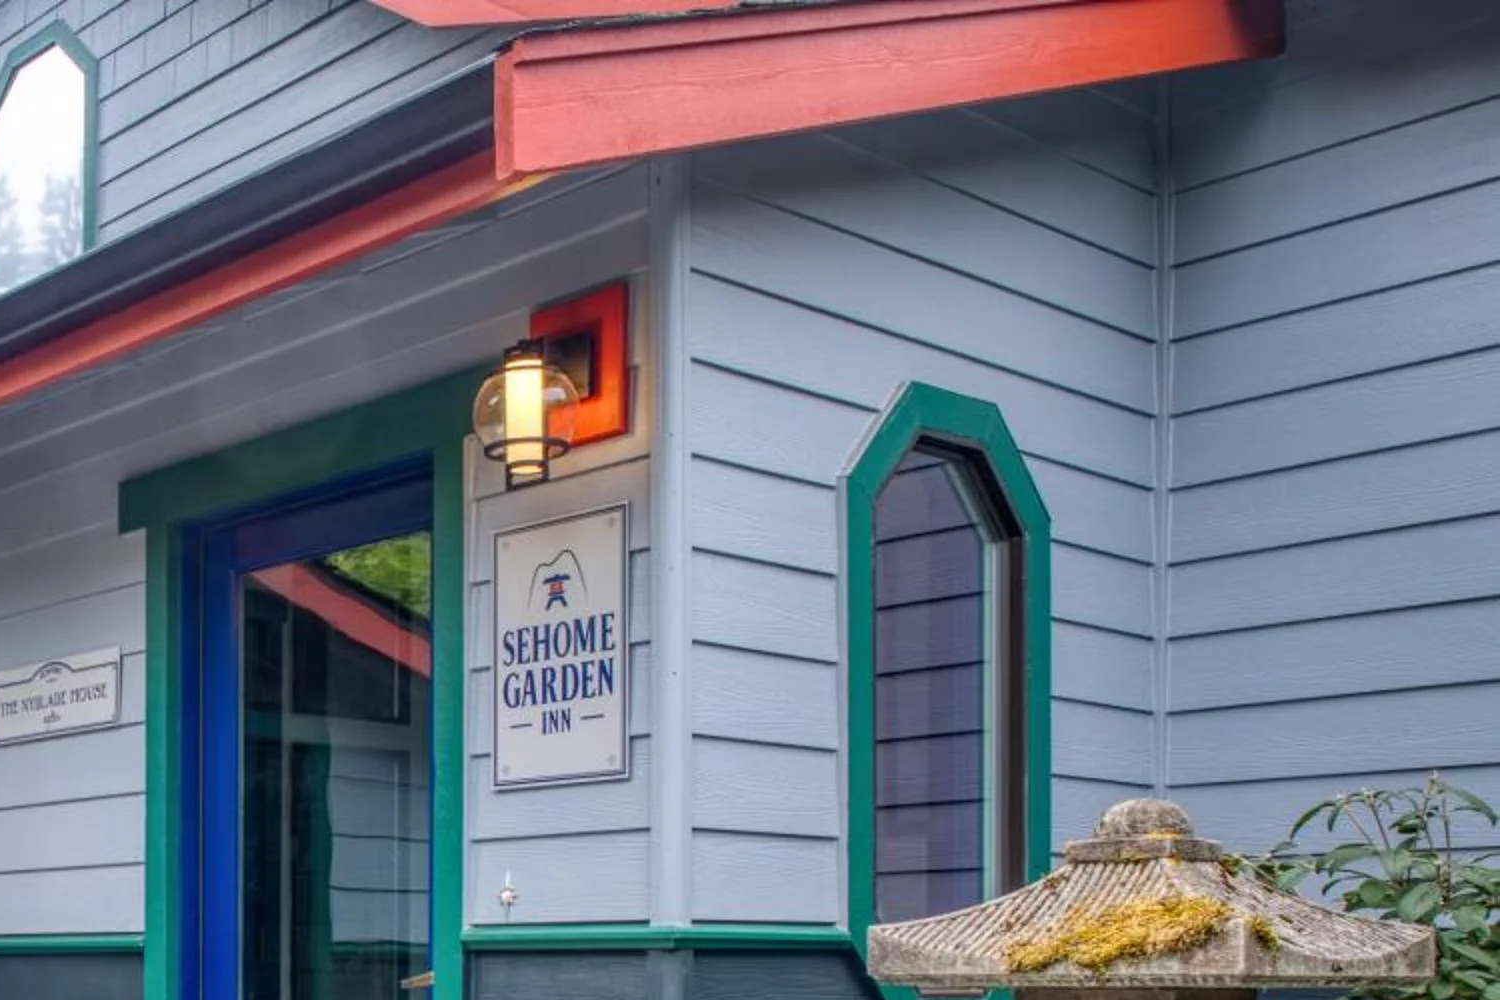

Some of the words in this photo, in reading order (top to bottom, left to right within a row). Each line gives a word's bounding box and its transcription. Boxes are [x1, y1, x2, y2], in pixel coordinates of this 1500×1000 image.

[503, 613, 615, 666] SEHOME
[503, 657, 614, 708] GARDEN
[542, 707, 571, 734] INN
